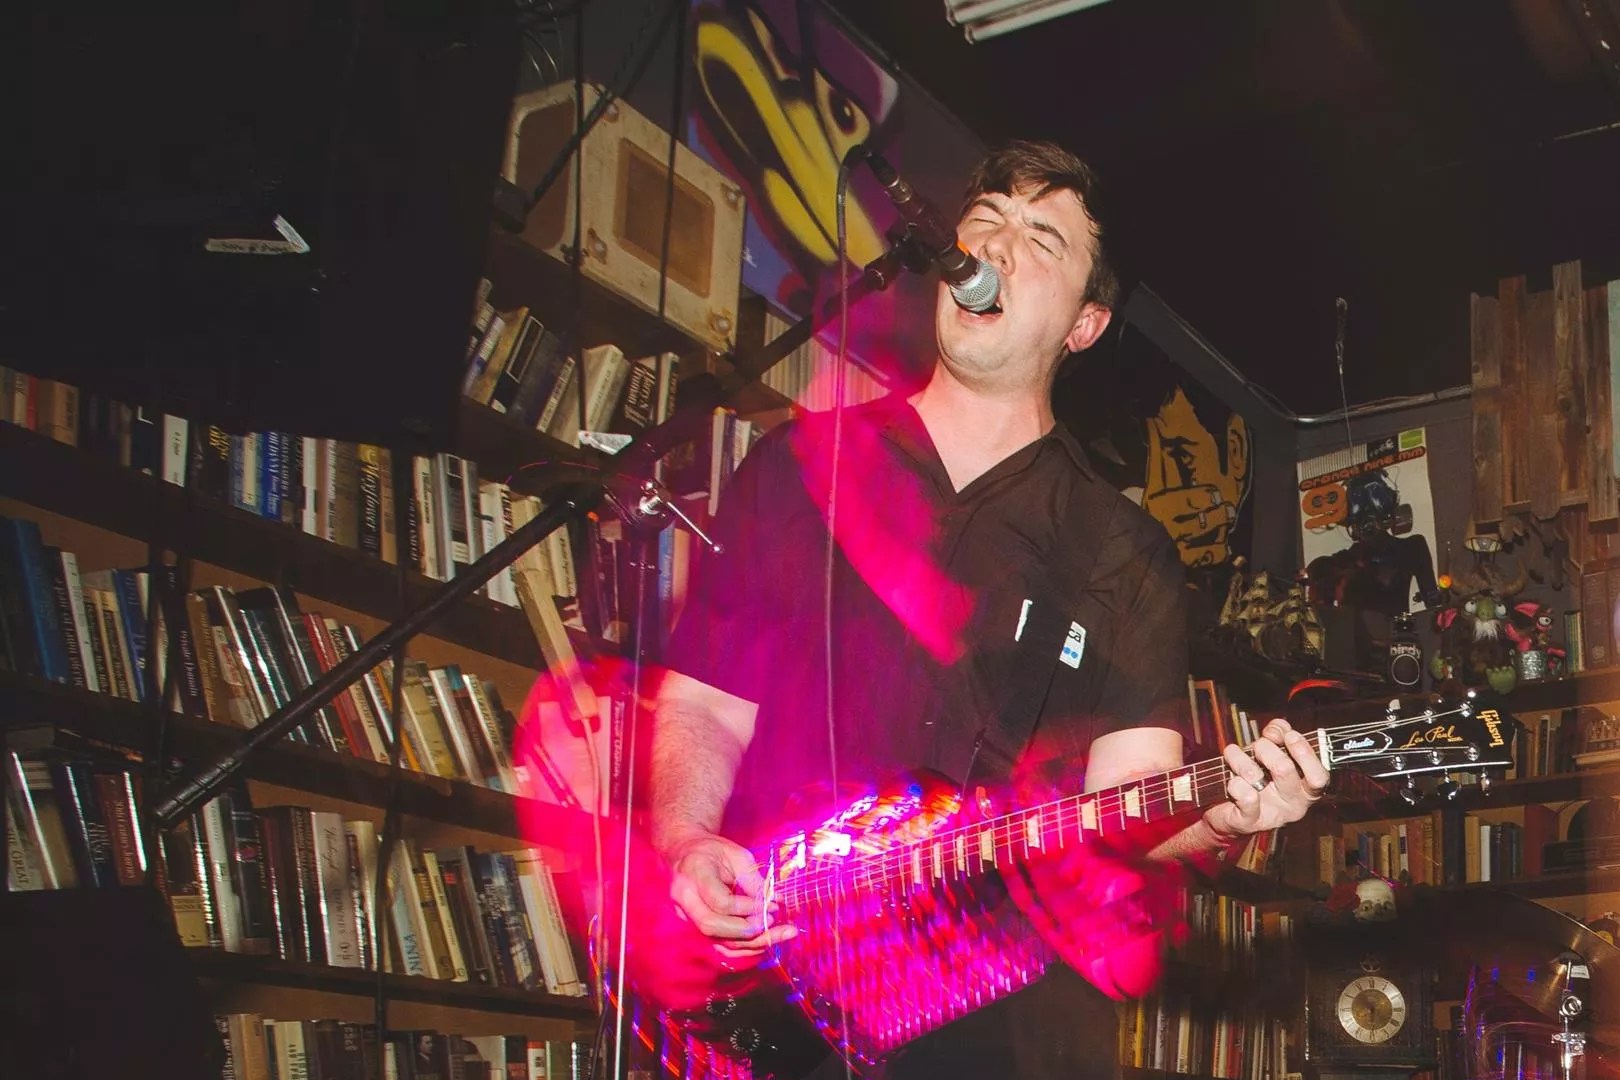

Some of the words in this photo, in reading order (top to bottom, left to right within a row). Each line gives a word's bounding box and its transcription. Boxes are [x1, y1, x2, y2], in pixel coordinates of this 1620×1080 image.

[638, 371, 656, 400] Harry
[1301, 466, 1360, 490] orange
[1364, 456, 1394, 473] nine
[1400, 447, 1424, 461] mm
[360, 463, 380, 532] Mayflower
[180, 630, 193, 666] Private
[184, 667, 199, 698] Domain
[1344, 737, 1375, 750] Studio
[1401, 732, 1424, 750] Les
[1425, 726, 1457, 743] Paul
[1477, 709, 1504, 748] Gibson
[114, 819, 129, 849] Century
[10, 849, 29, 885] GREAT
[119, 850, 134, 880] Journey
